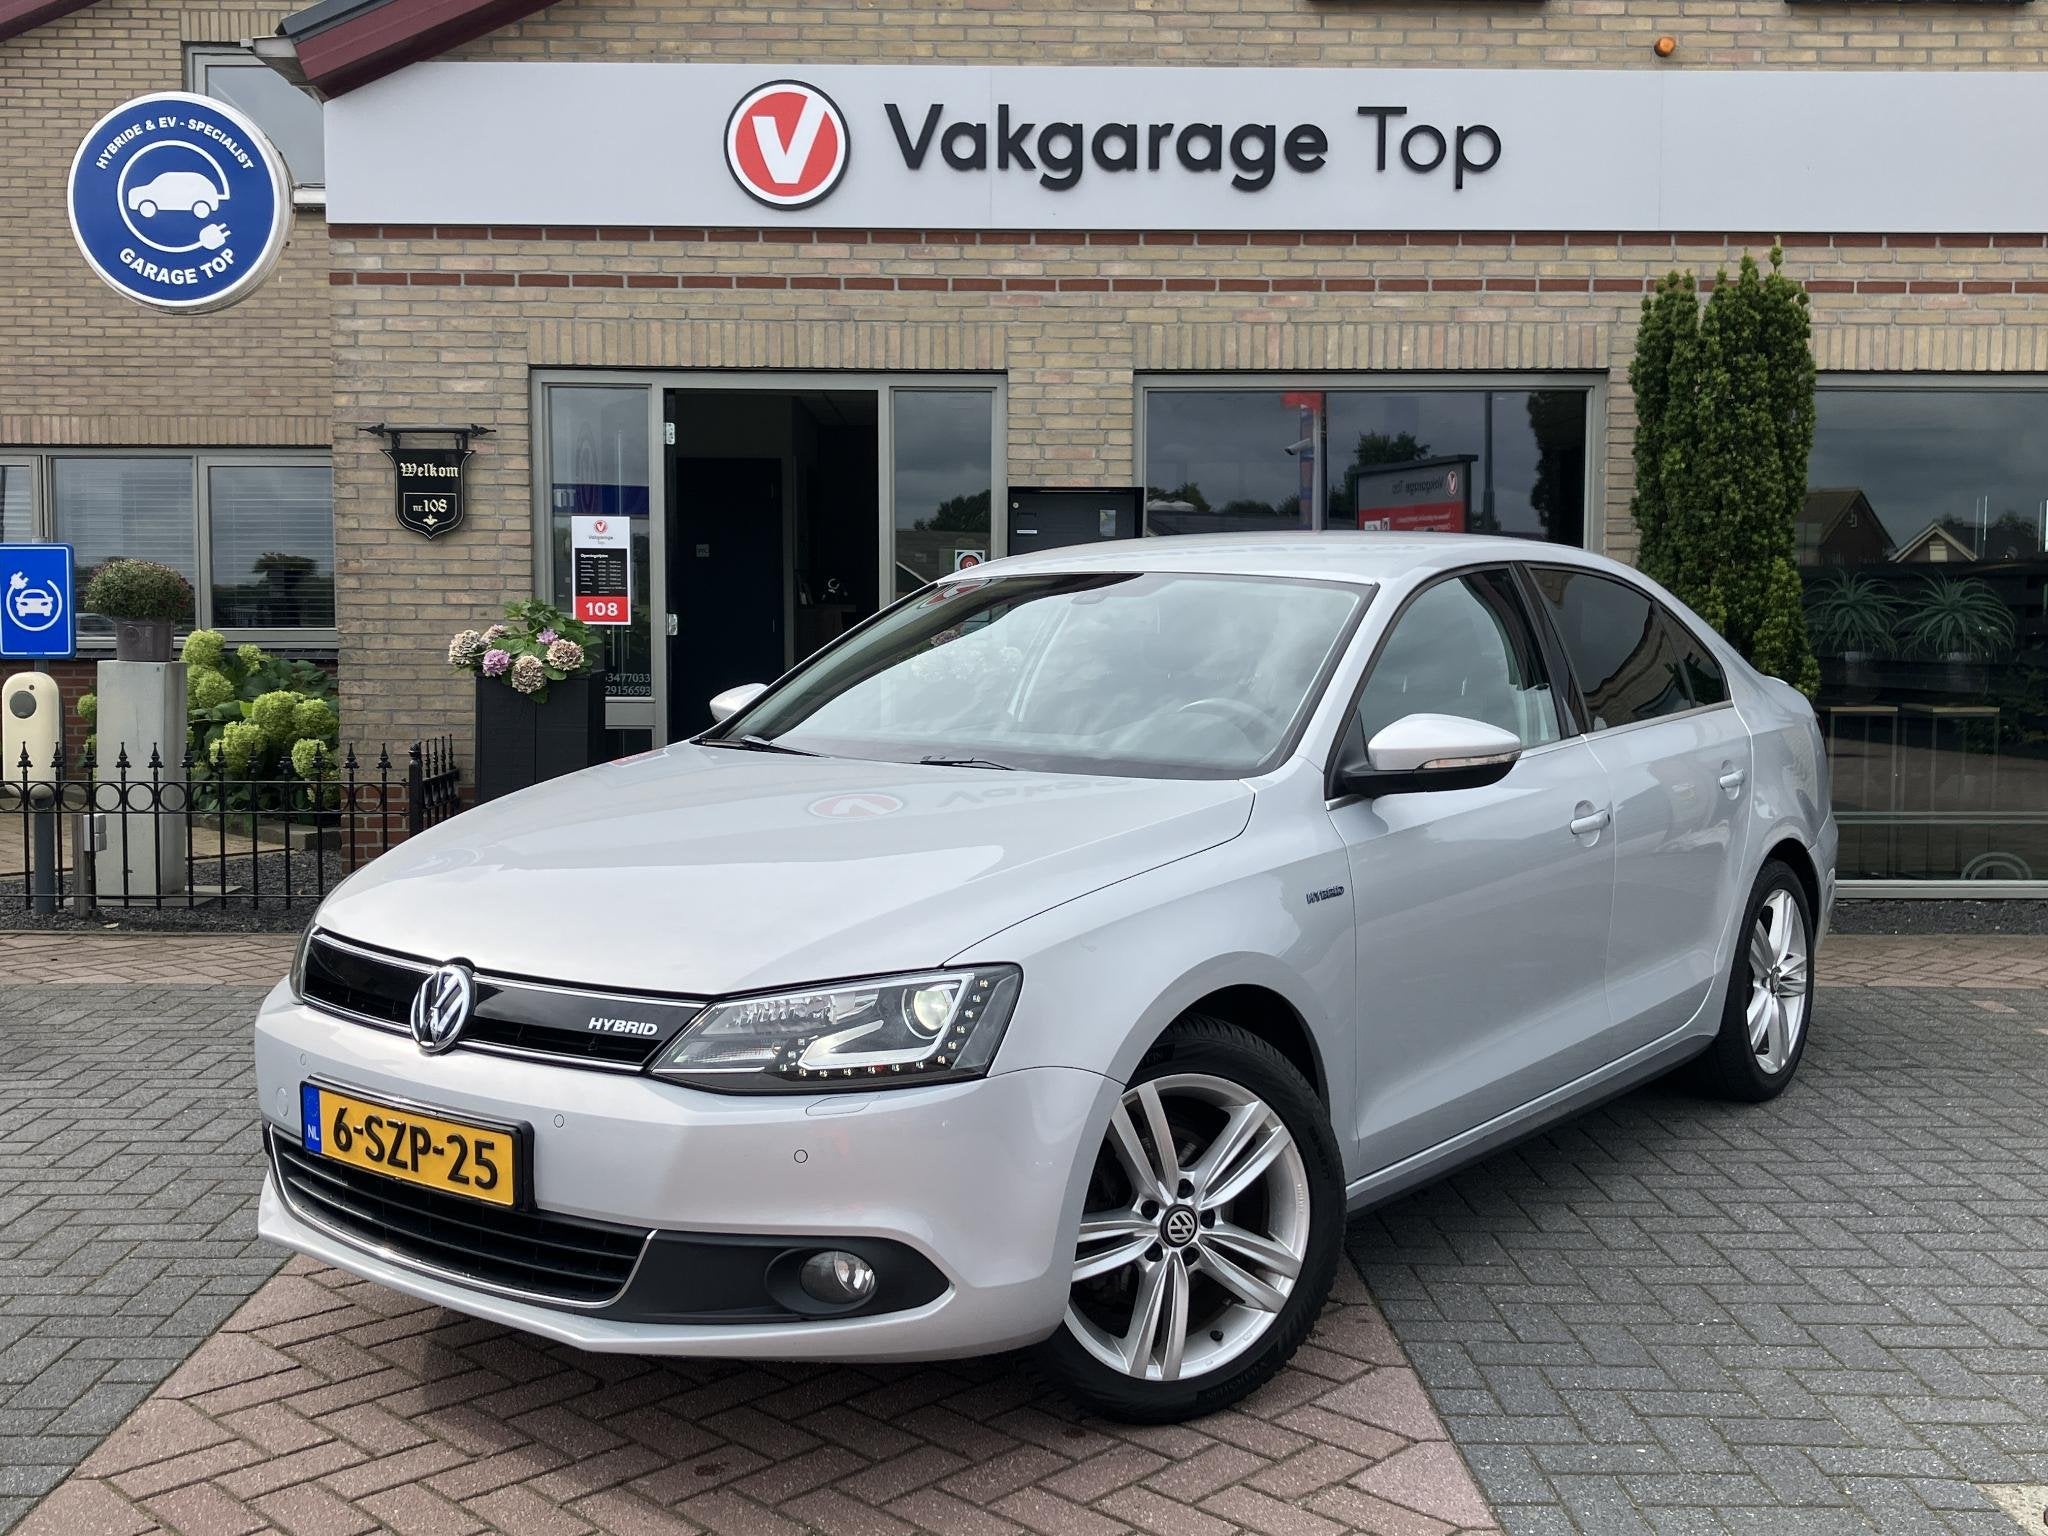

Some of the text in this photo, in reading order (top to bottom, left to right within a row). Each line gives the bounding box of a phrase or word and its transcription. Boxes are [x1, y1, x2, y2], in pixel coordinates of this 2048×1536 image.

[95, 123, 143, 170] HYBRIDE
[145, 119, 156, 130] &
[158, 116, 177, 128] EV
[187, 118, 254, 170] SPECIALIST
[883, 103, 1502, 192] Vakgarage Top
[119, 247, 235, 285] GARAGE TOP
[399, 462, 459, 477] Welkom
[585, 602, 618, 616] 108
[588, 1016, 658, 1036] HYBRID
[307, 1124, 320, 1141] NL
[333, 1106, 498, 1190] 6-SZP-25
